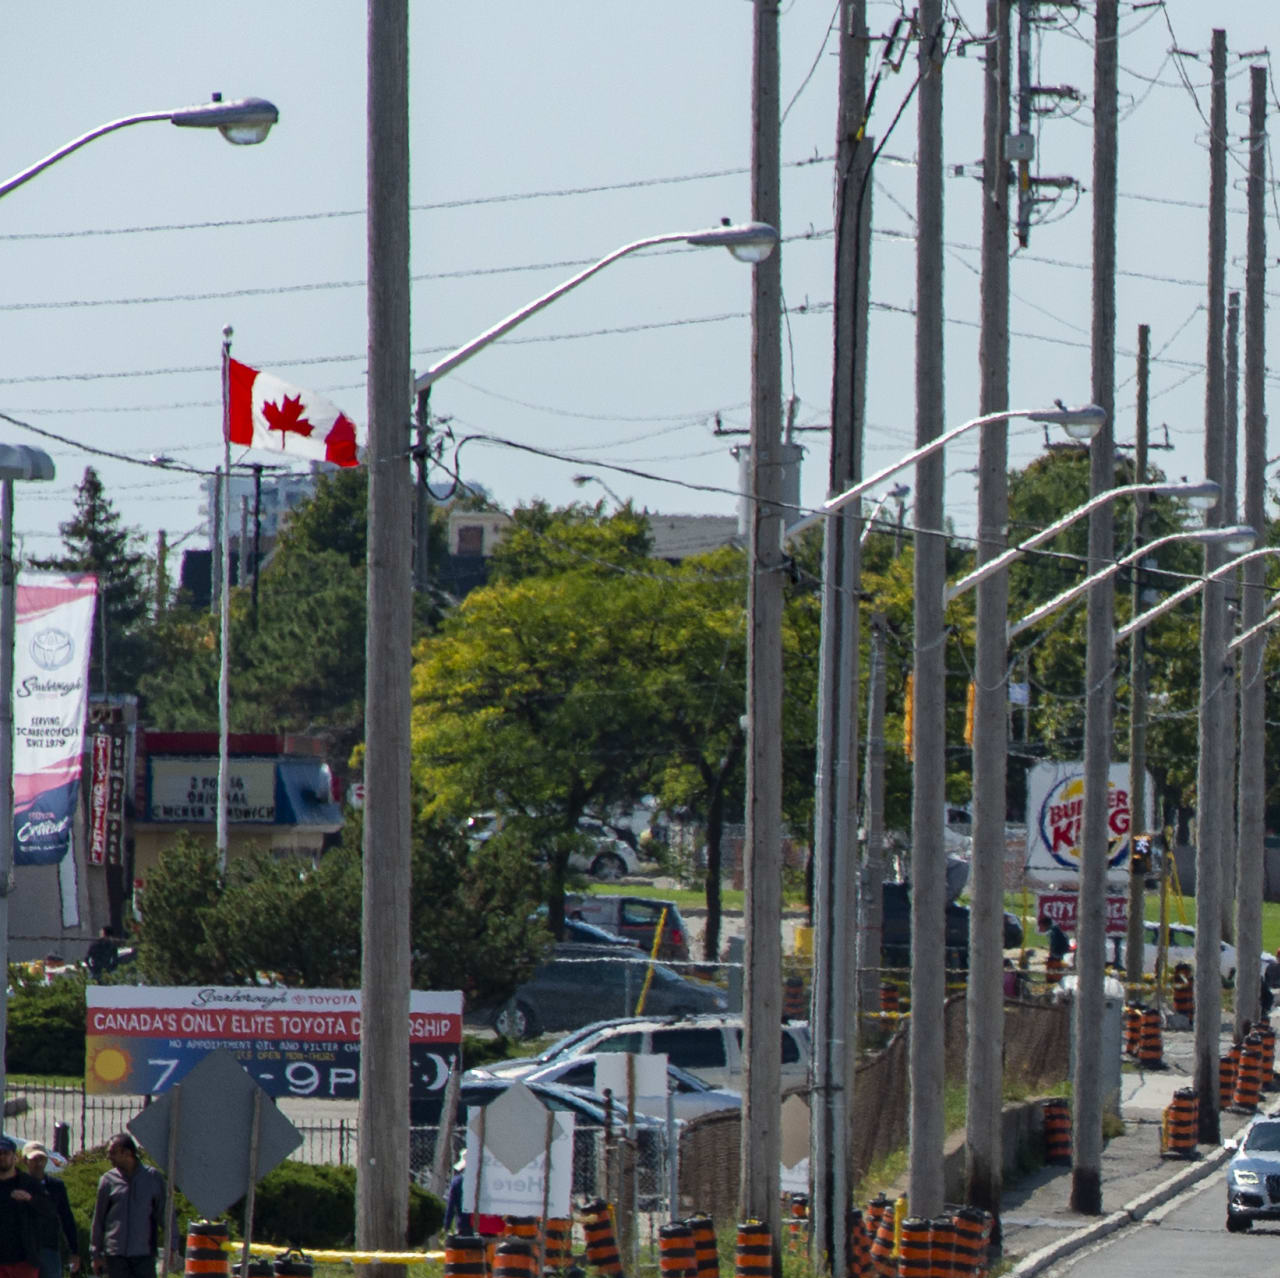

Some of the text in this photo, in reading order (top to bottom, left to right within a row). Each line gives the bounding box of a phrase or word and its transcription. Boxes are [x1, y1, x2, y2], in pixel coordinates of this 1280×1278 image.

[211, 806, 275, 818] SNDWICH
[307, 995, 357, 1005] TOYOTA
[94, 1013, 177, 1032] CANADA'S
[181, 1013, 227, 1033] ONLY
[232, 1016, 275, 1034] ELITE
[279, 1017, 346, 1036] TOYOTA
[168, 1040, 182, 1049] NO
